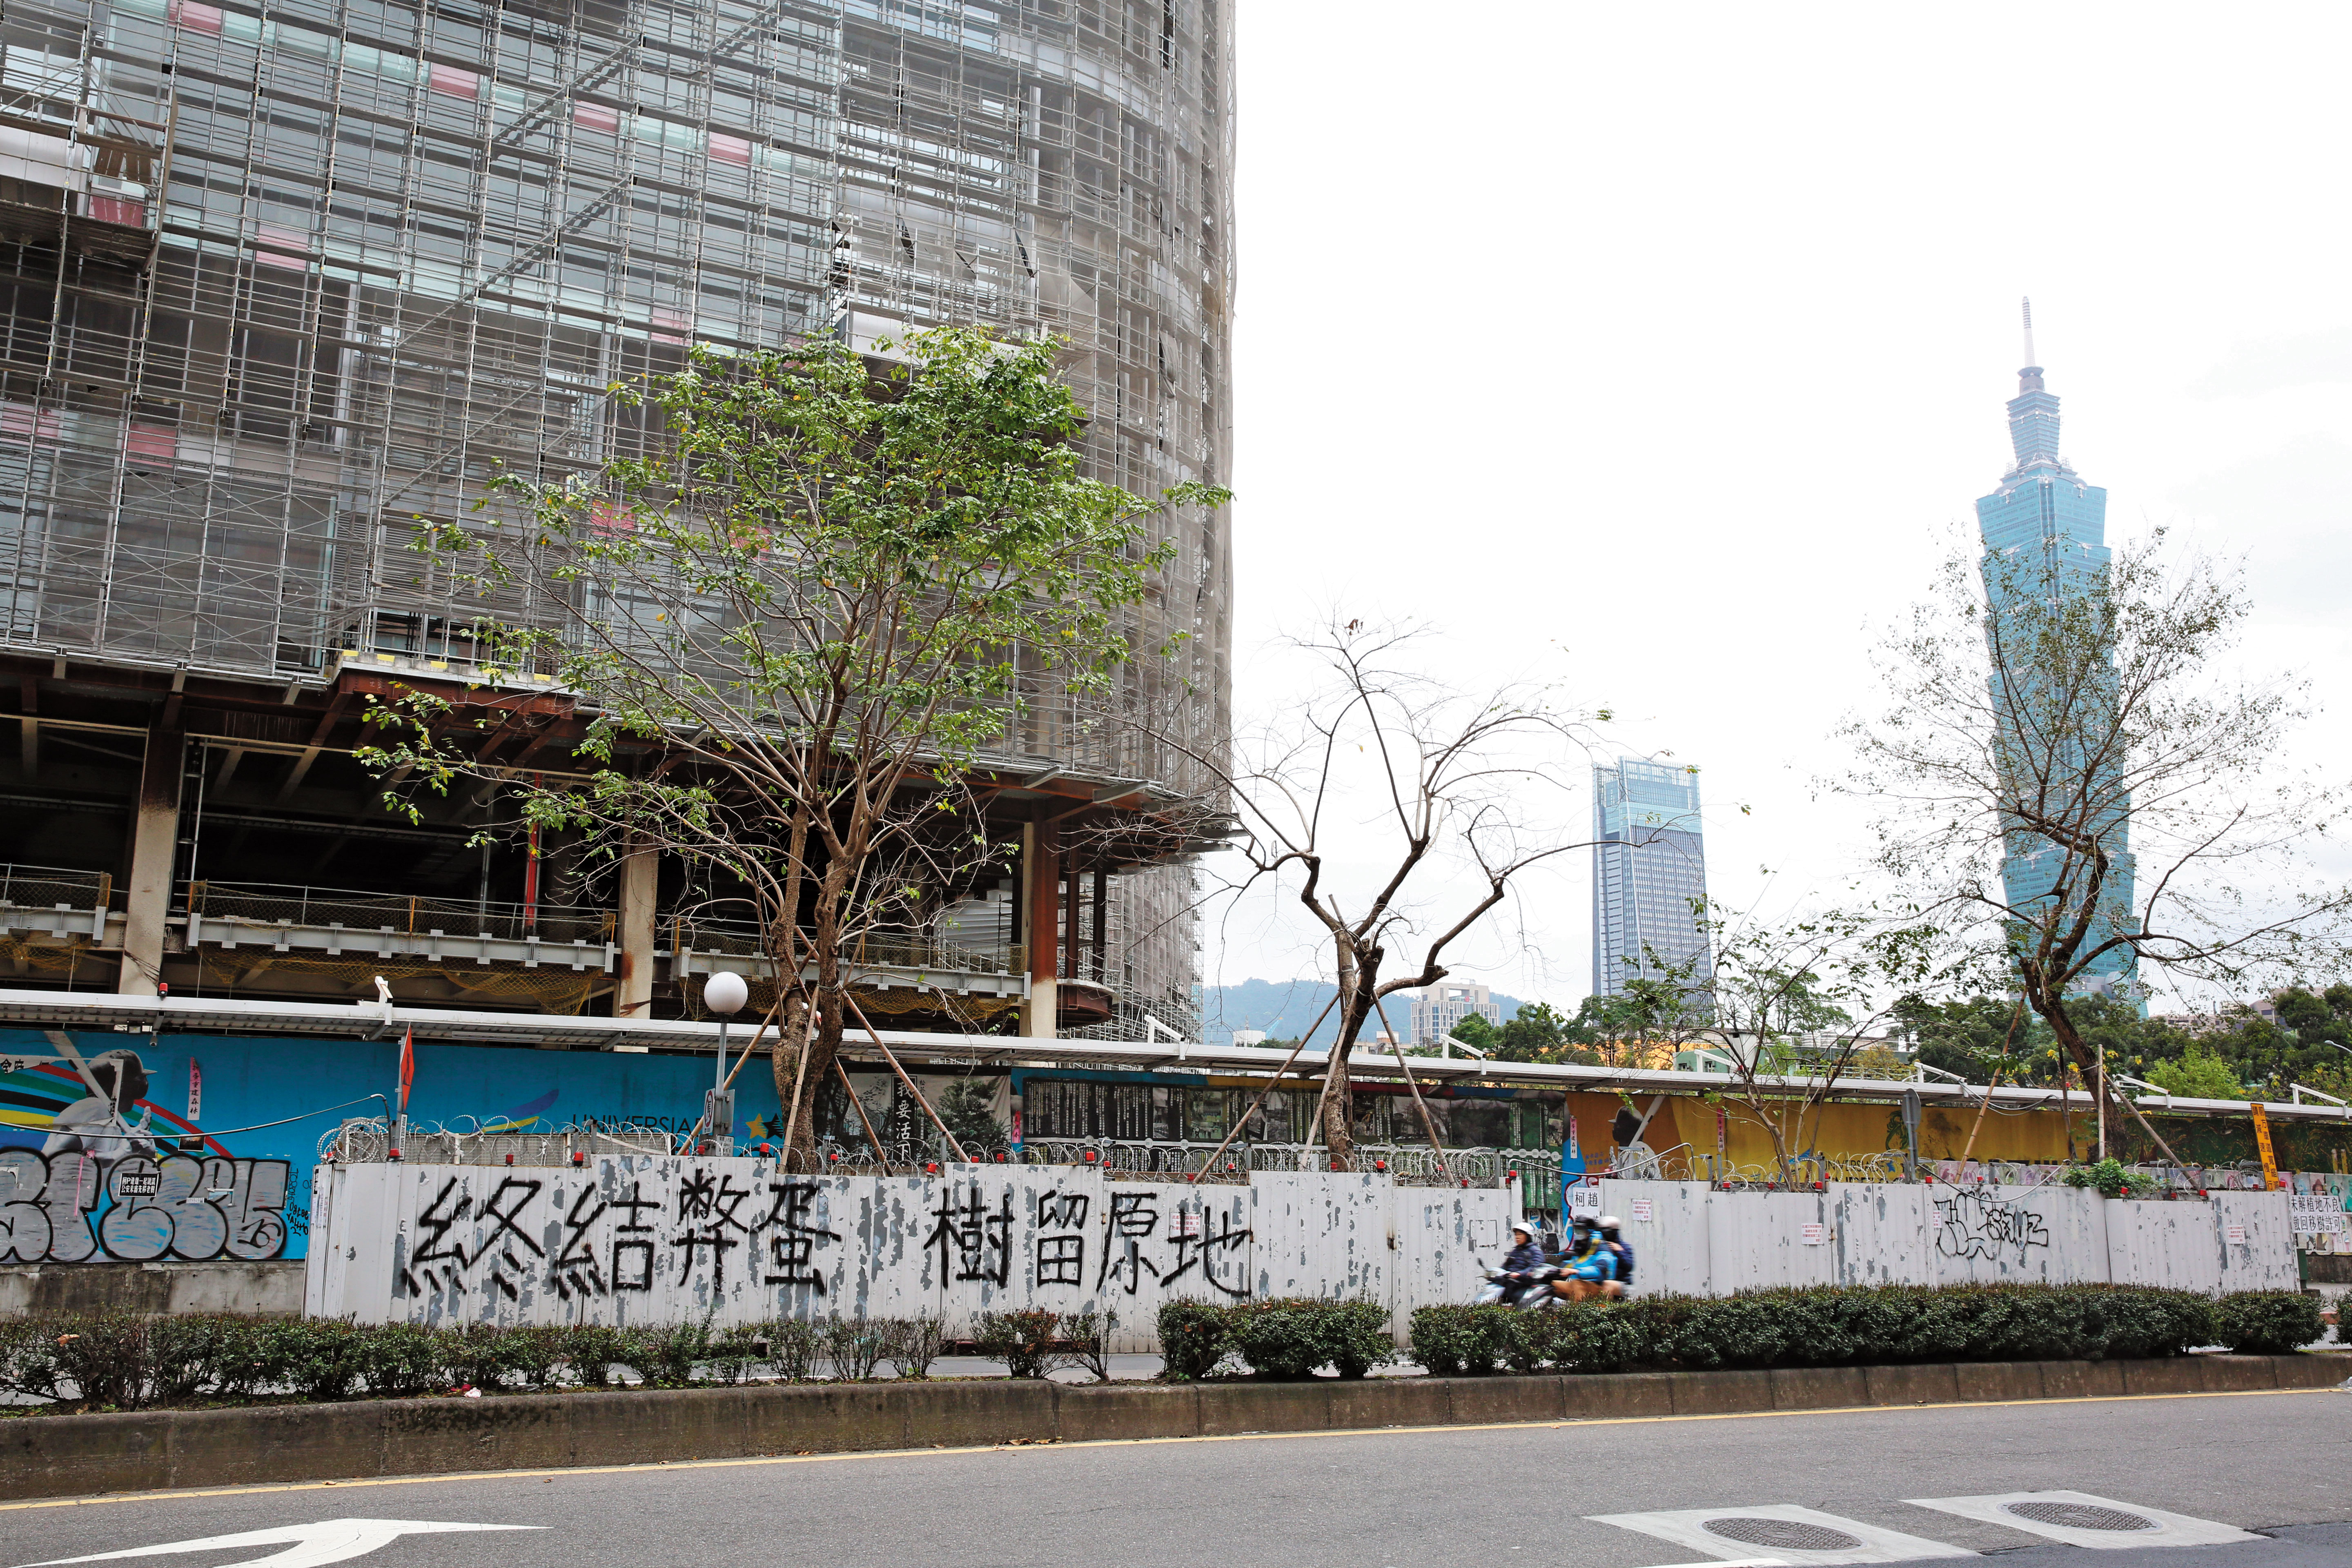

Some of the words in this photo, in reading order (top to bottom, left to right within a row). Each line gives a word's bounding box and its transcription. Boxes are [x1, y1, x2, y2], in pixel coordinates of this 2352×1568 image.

[572, 1114, 705, 1137] UNIVERSIA
[2291, 1196, 2339, 1212] 未解植地不良
[924, 1187, 1252, 1297] 樹留原地
